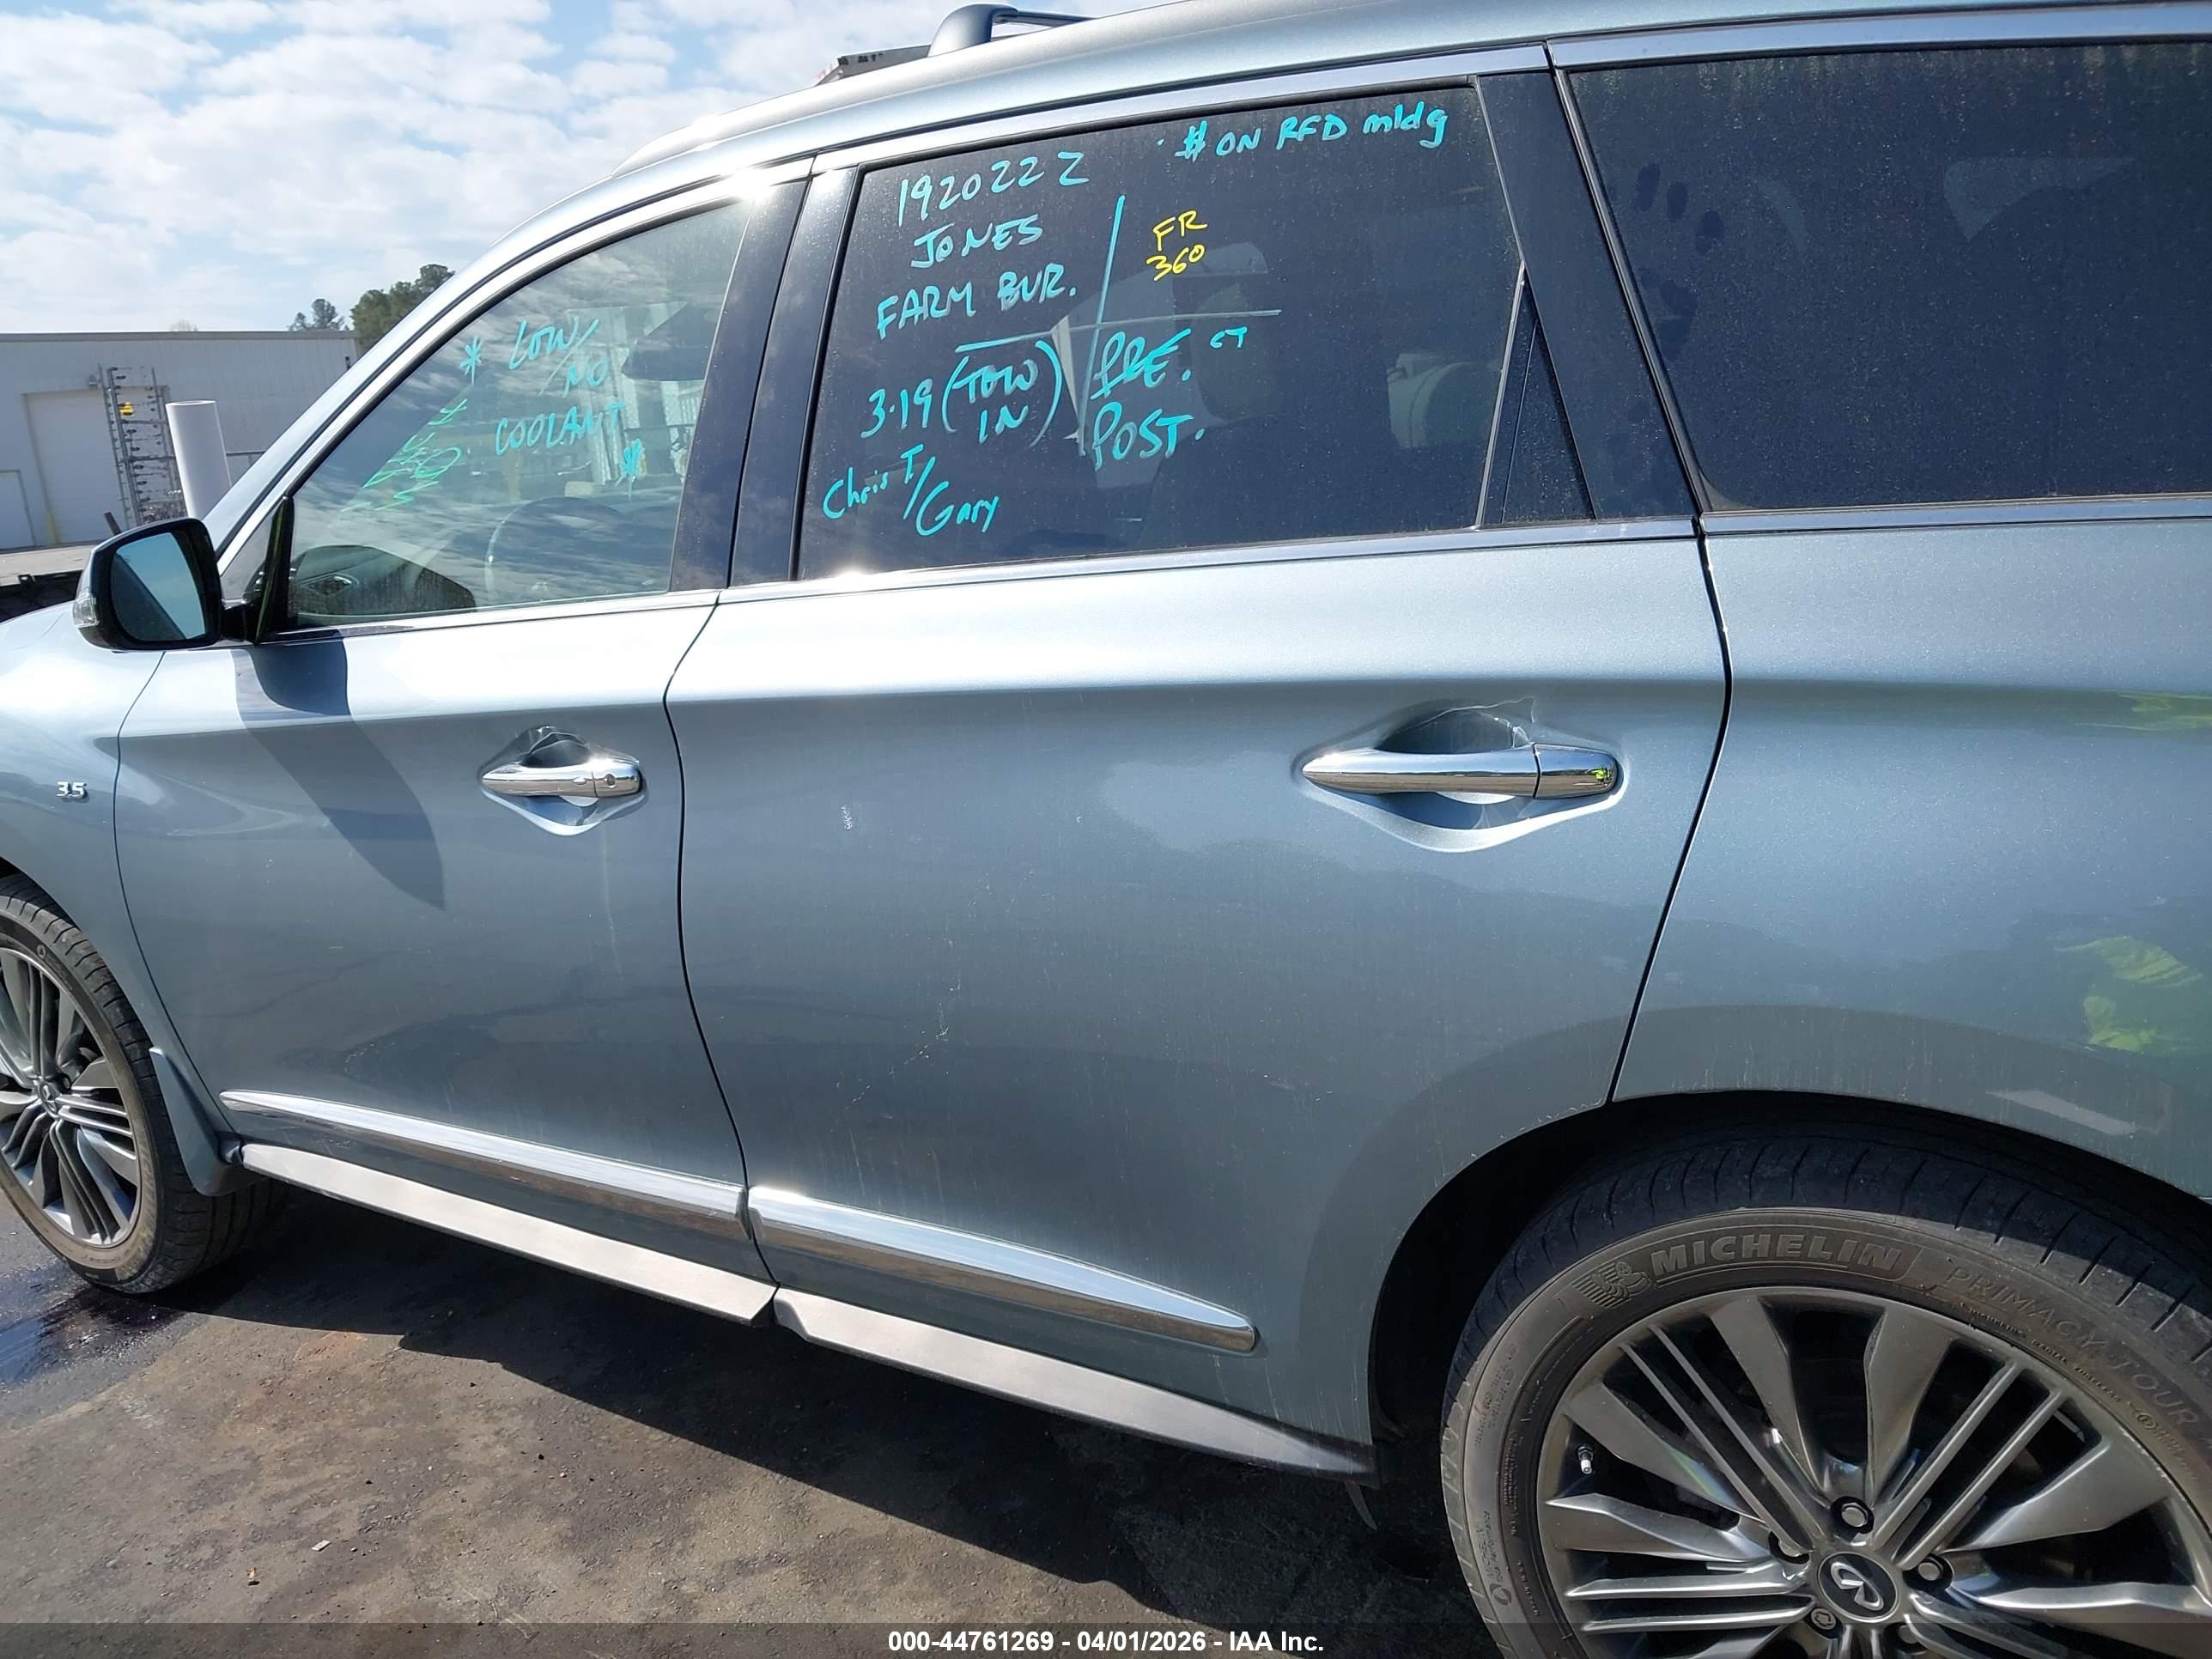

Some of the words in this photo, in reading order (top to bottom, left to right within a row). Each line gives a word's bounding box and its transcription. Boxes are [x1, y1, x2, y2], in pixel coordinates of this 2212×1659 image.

[1215, 128, 1262, 157] ON
[911, 214, 1045, 269] JONES
[1153, 210, 1207, 252] FR
[1146, 244, 1205, 281] 360
[877, 288, 977, 339] FARM
[495, 401, 626, 456] COOLANT
[1650, 1234, 1904, 1277] MICHELIN
[1946, 1266, 2107, 1349] PRIMACY
[2112, 1359, 2200, 1425] TOUR
